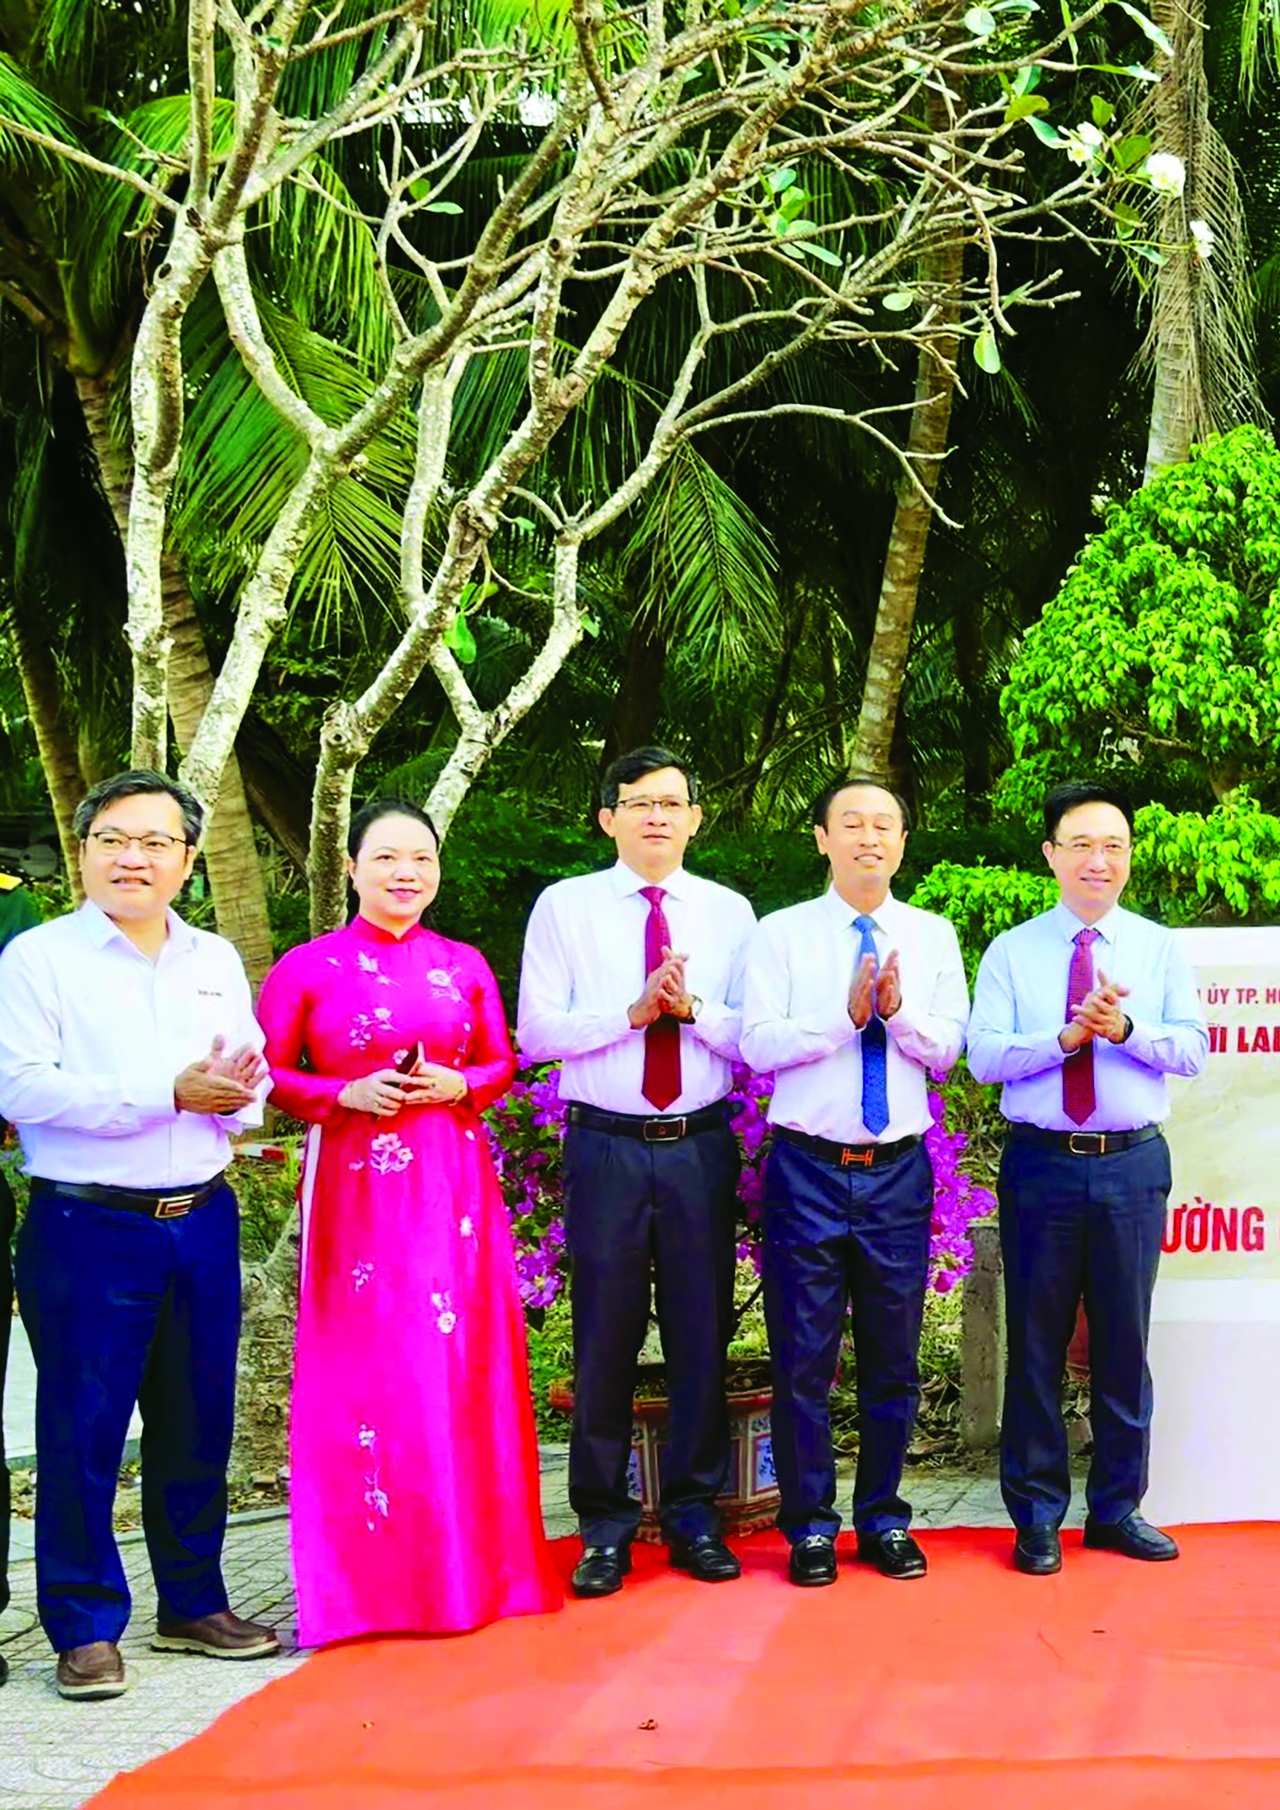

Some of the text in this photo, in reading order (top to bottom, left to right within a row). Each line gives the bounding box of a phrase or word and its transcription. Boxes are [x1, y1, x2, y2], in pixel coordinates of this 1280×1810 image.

[1207, 982, 1229, 1005] ỦY
[1236, 987, 1259, 1004] TP.
[1161, 1197, 1266, 1253] ƯỜNG
